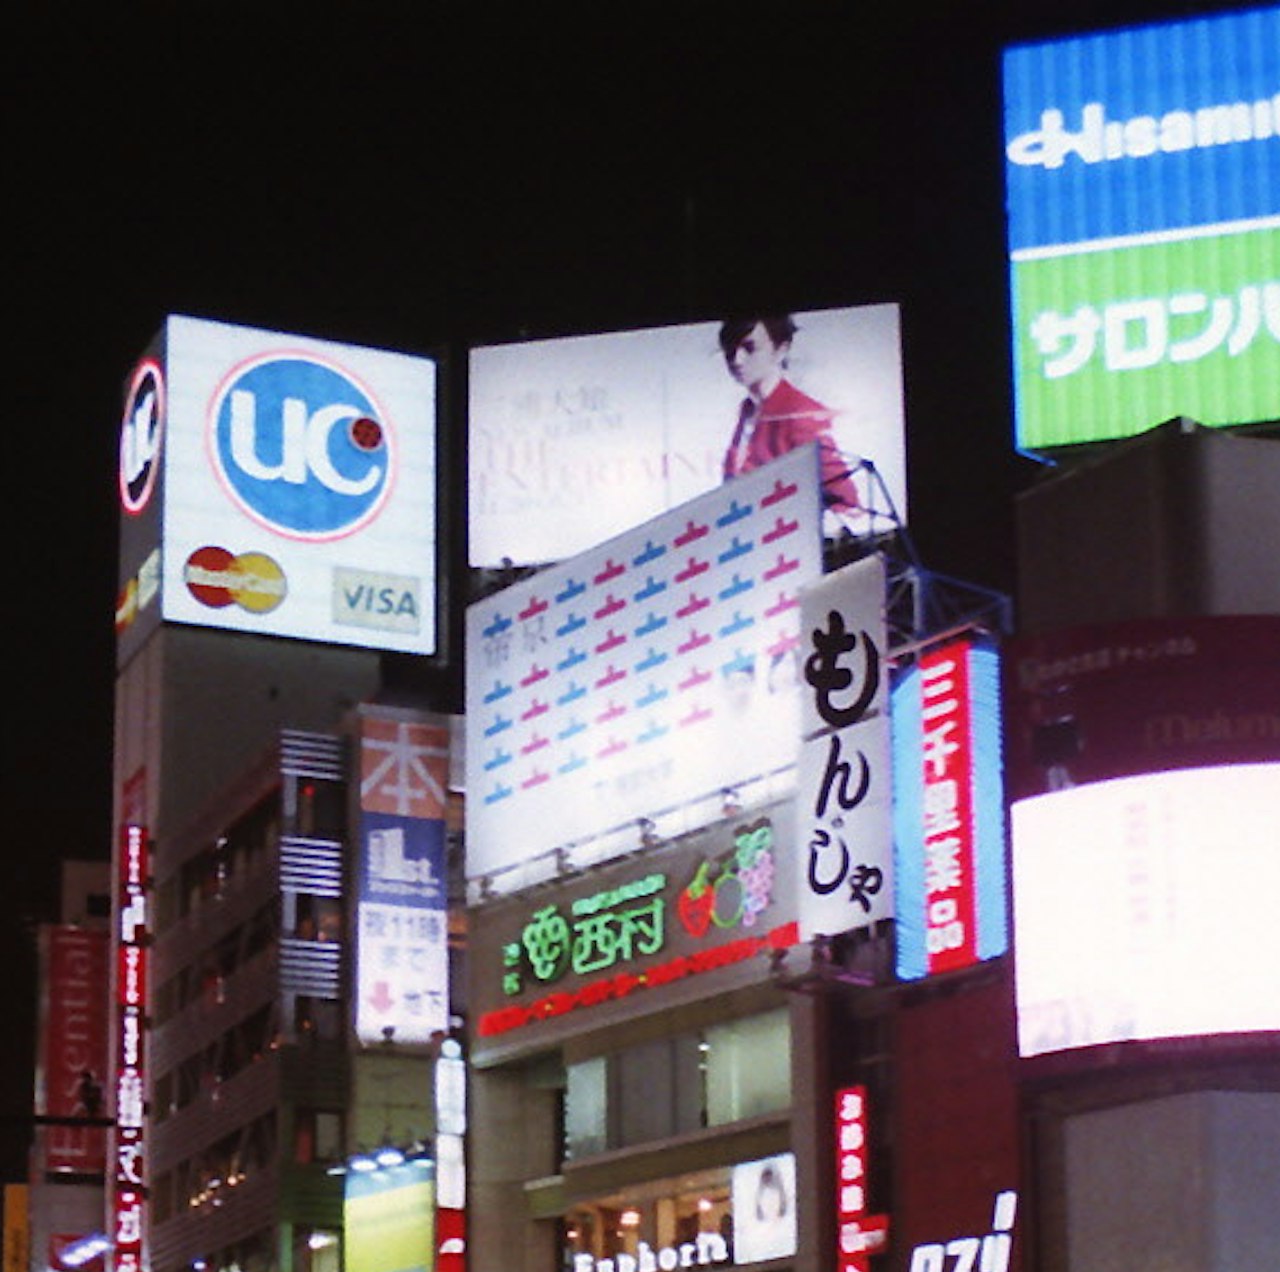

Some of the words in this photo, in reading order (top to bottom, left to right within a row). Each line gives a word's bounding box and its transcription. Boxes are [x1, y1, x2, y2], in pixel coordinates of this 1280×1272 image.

[230, 389, 381, 496] UC
[343, 584, 418, 617] VISA
[360, 720, 449, 818] 本
[804, 608, 883, 914] もんじゃ
[919, 658, 965, 954] 三千里薬品
[571, 897, 665, 976] 西村
